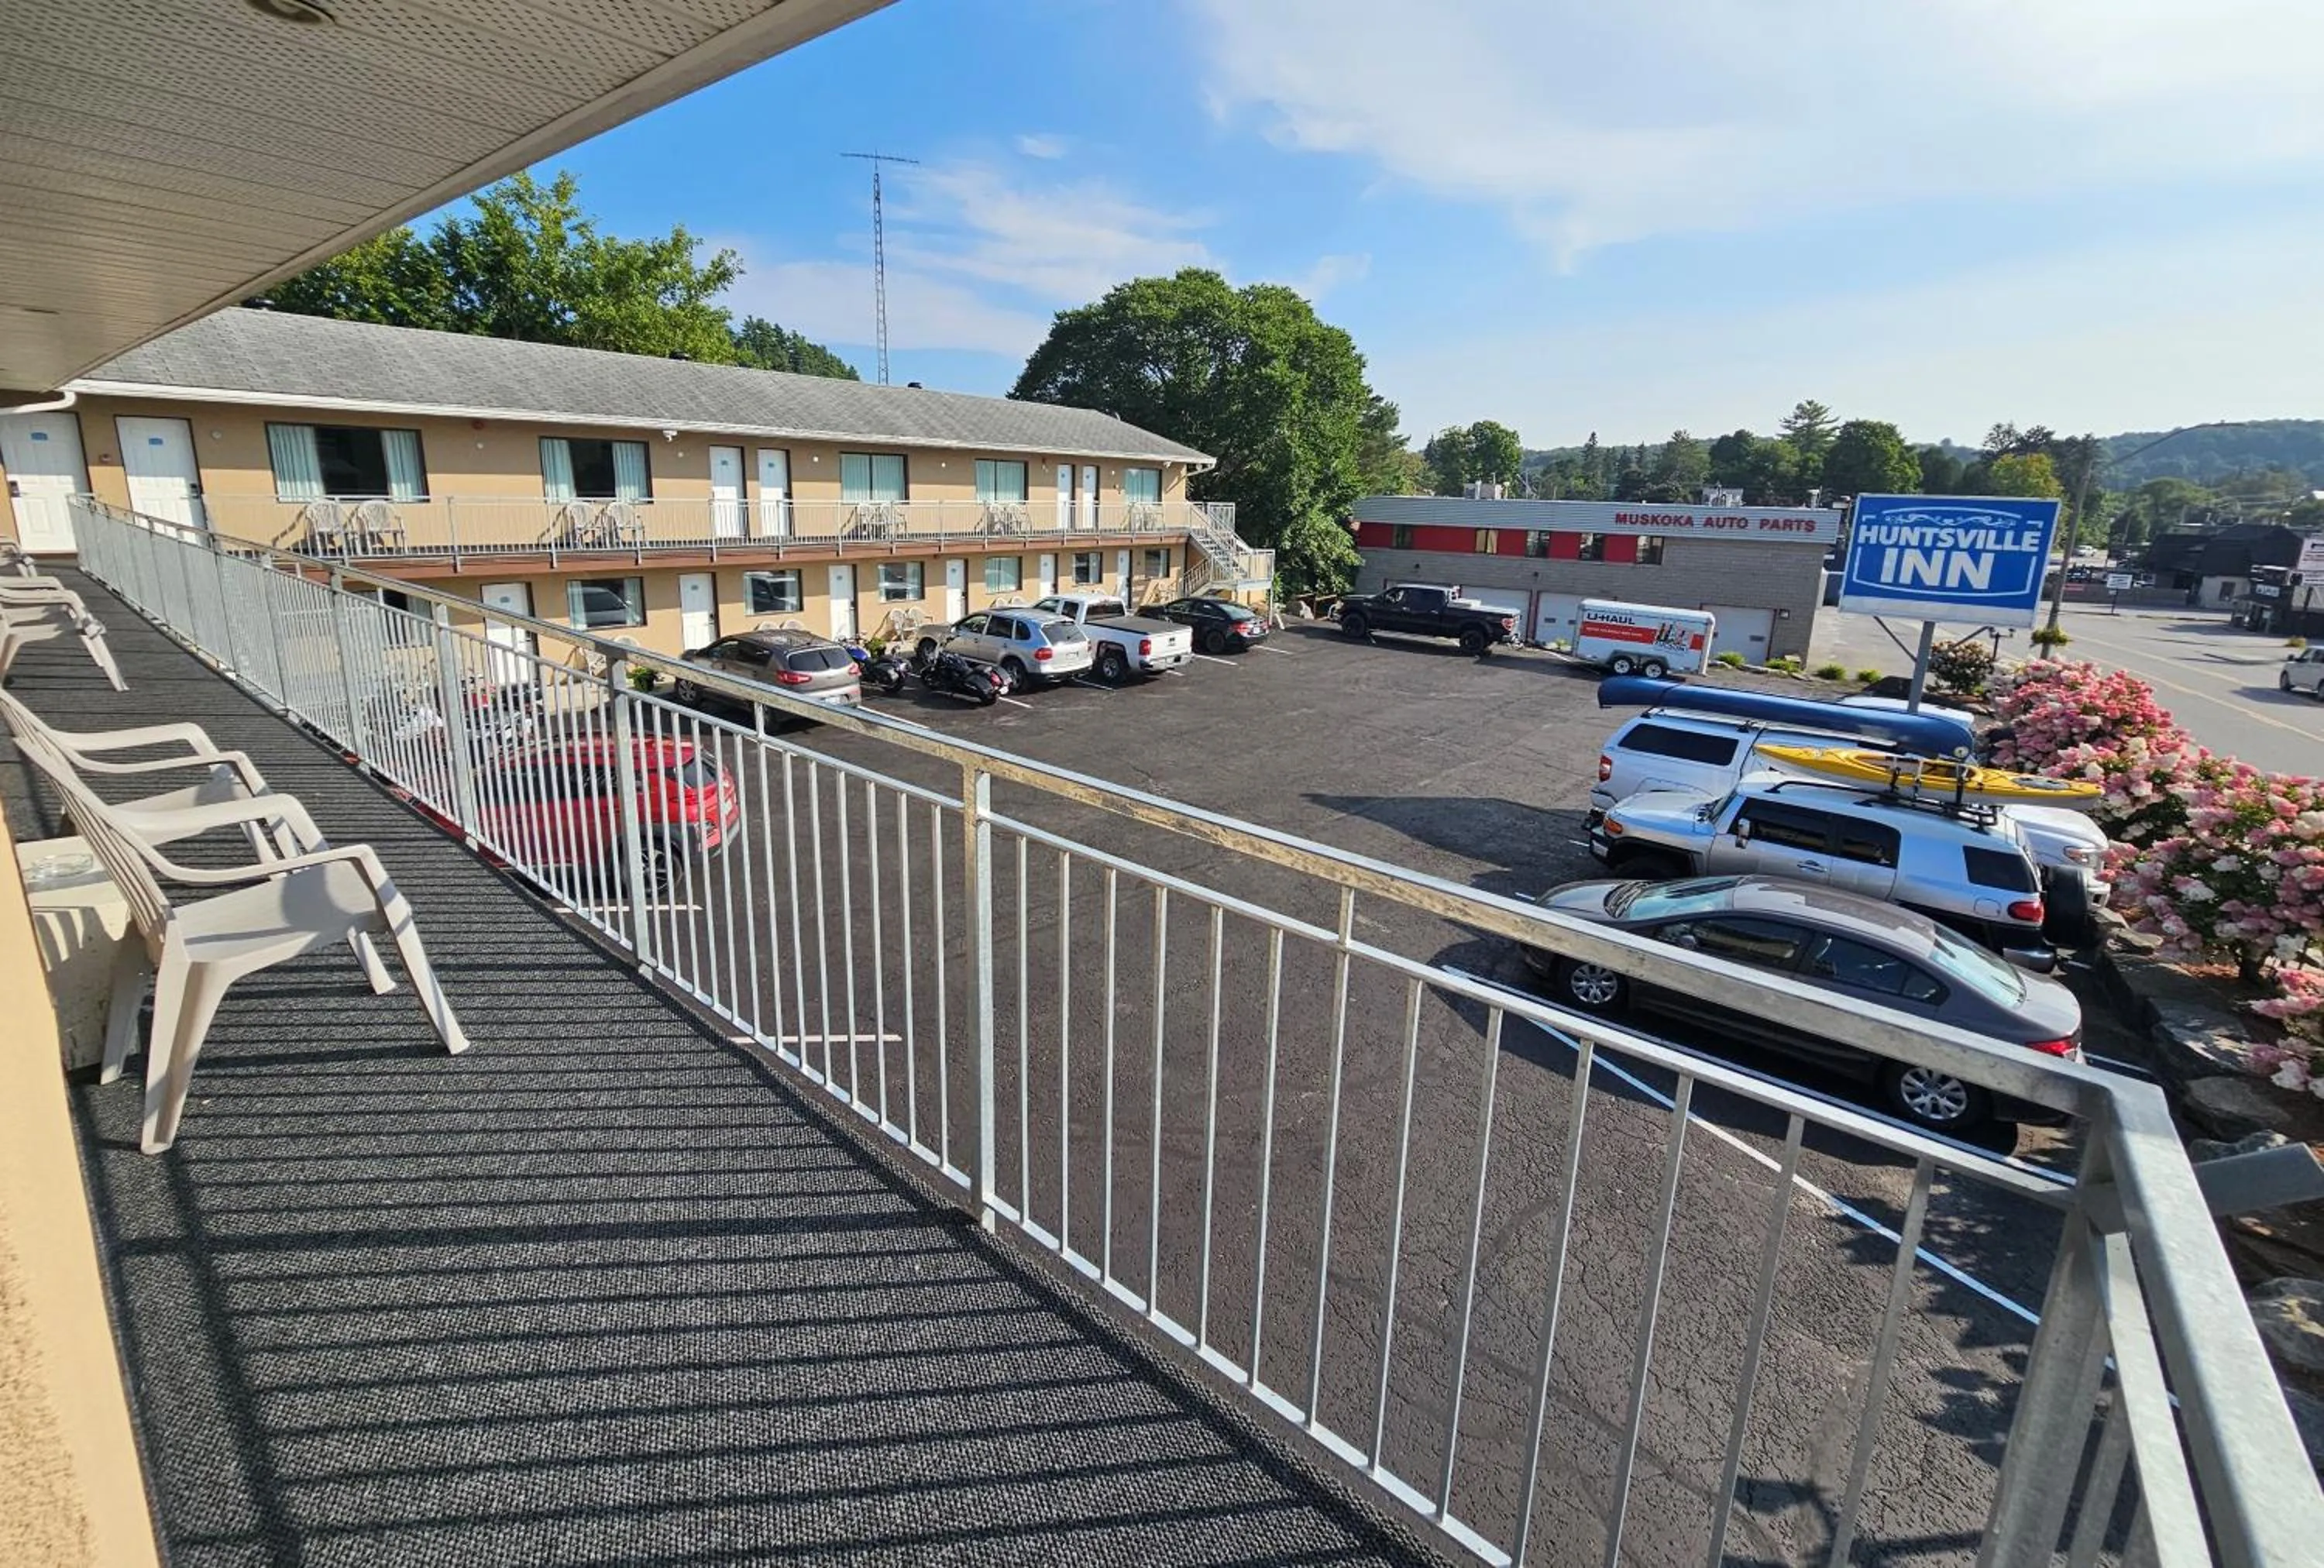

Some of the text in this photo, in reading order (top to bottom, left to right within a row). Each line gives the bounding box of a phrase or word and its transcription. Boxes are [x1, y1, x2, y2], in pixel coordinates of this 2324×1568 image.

[1614, 512, 1817, 533] MUSKOKA AUTO PARTS
[1858, 524, 2042, 552] HUNTSVILLE
[1880, 547, 1996, 590] INN
[1587, 612, 1635, 625] U-HAUL
